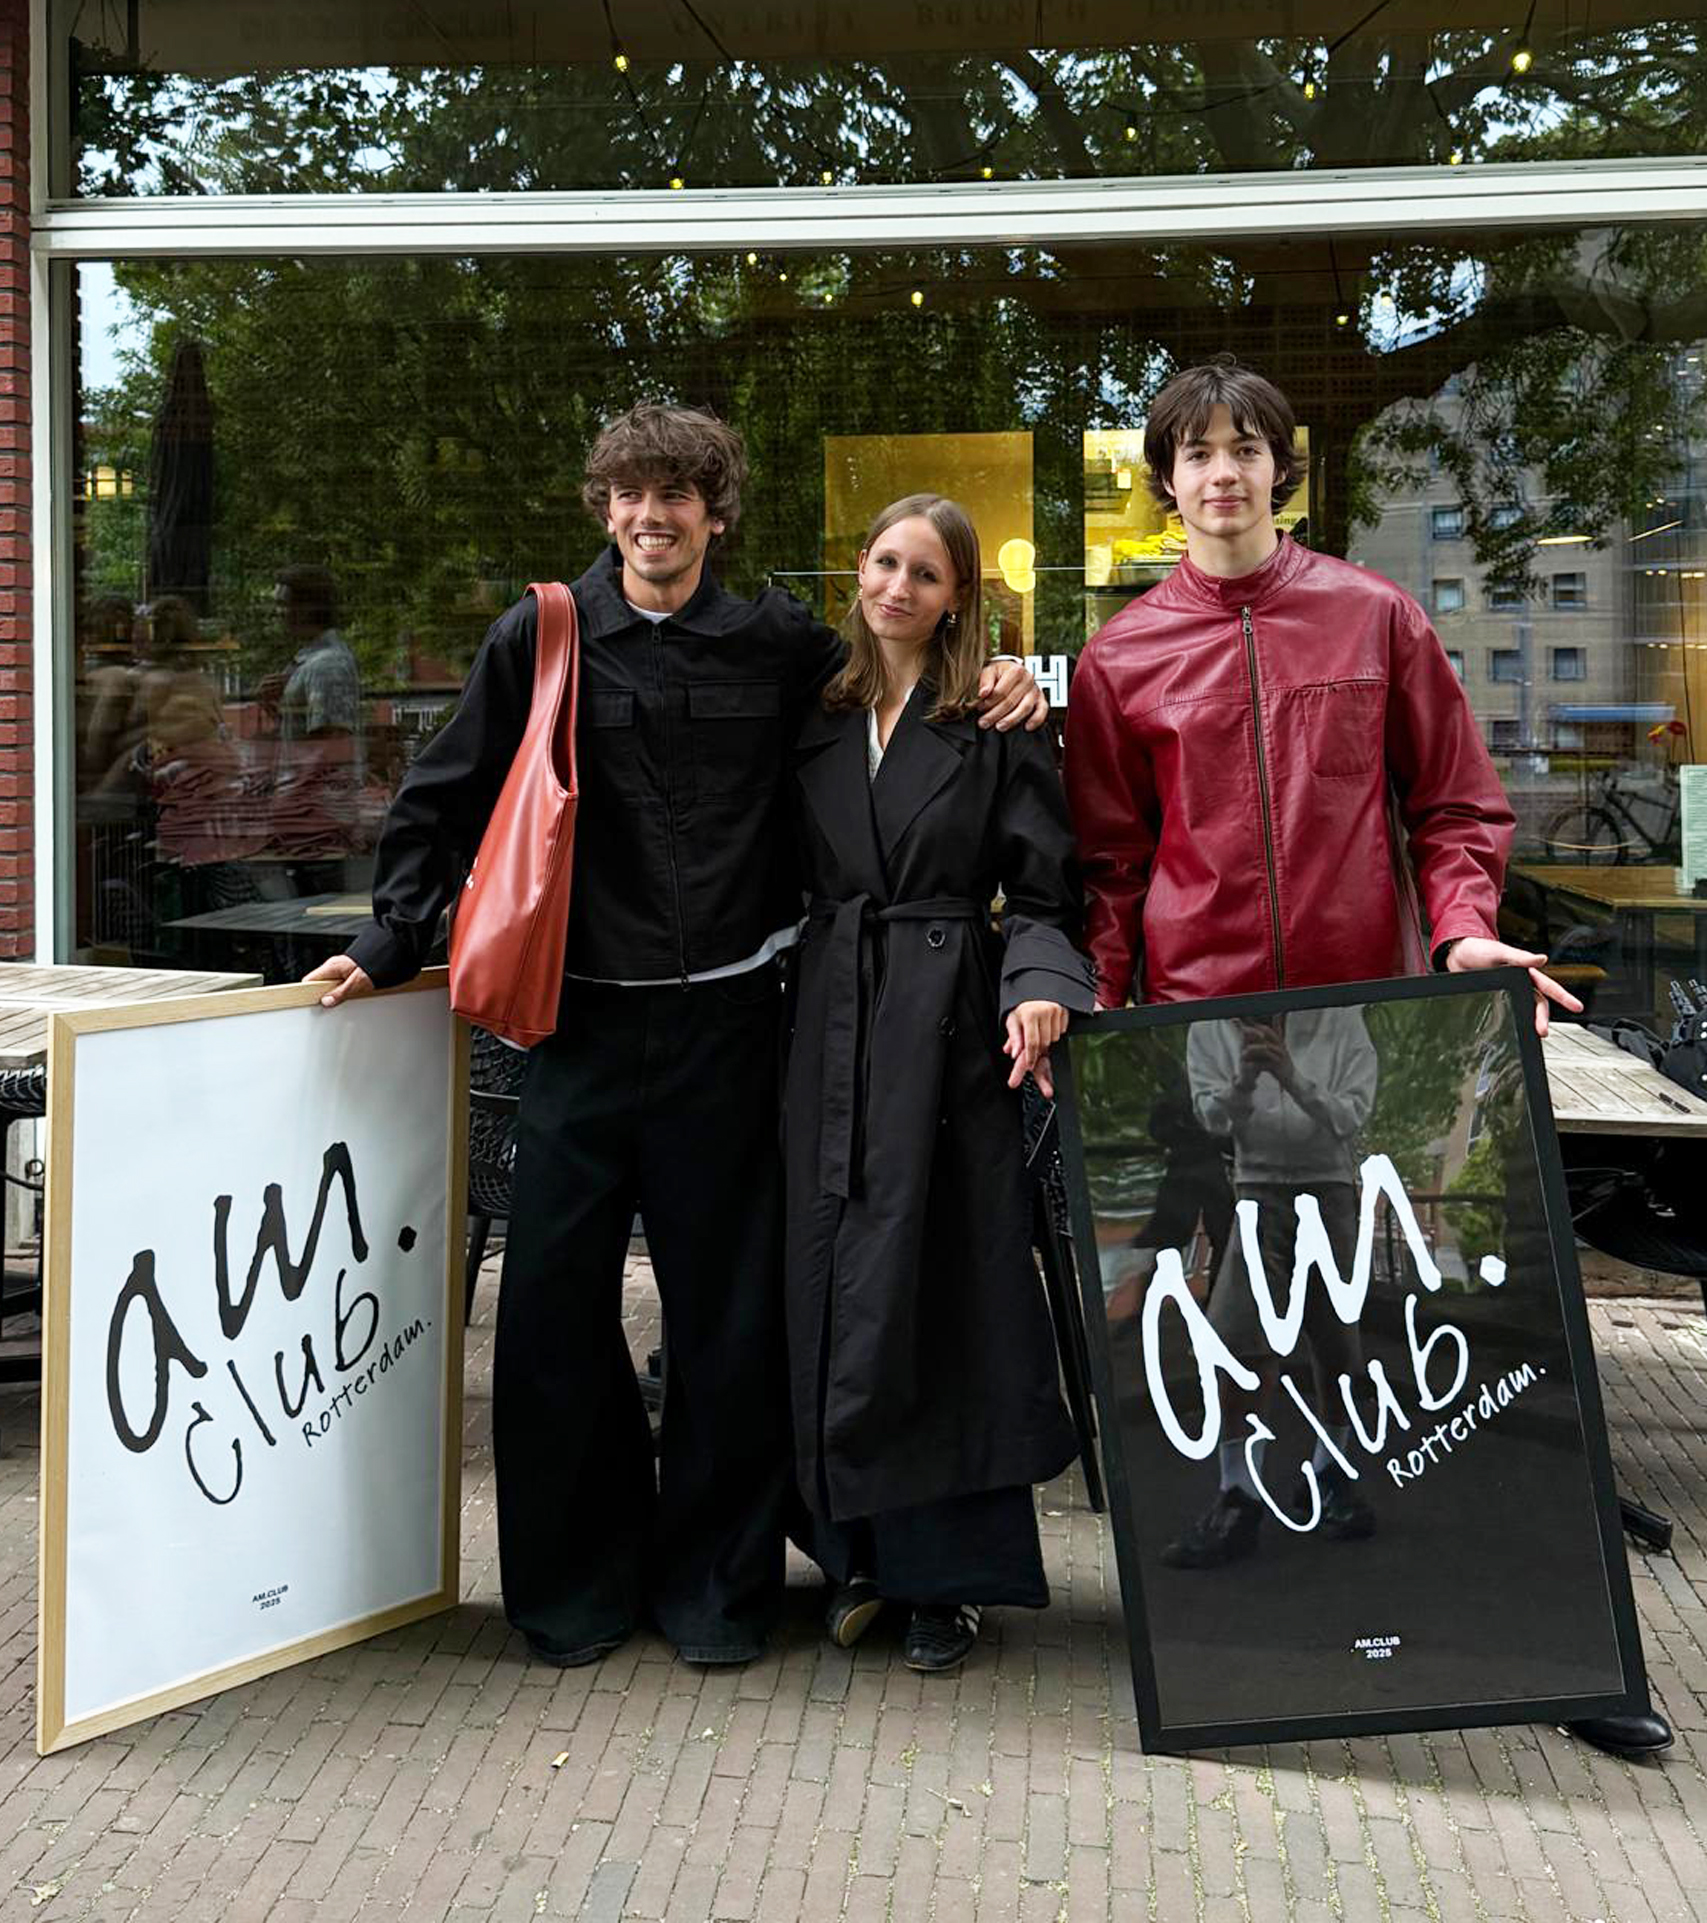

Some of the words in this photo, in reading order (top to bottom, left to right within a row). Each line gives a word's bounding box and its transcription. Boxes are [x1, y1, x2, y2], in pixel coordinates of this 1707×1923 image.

[302, 1318, 433, 1448] Rotterdam.
[1386, 1363, 1547, 1488] Rotterdam.
[260, 1597, 281, 1611] 2025
[1354, 1635, 1401, 1649] AM.CLUB
[1365, 1647, 1392, 1659] 2025
